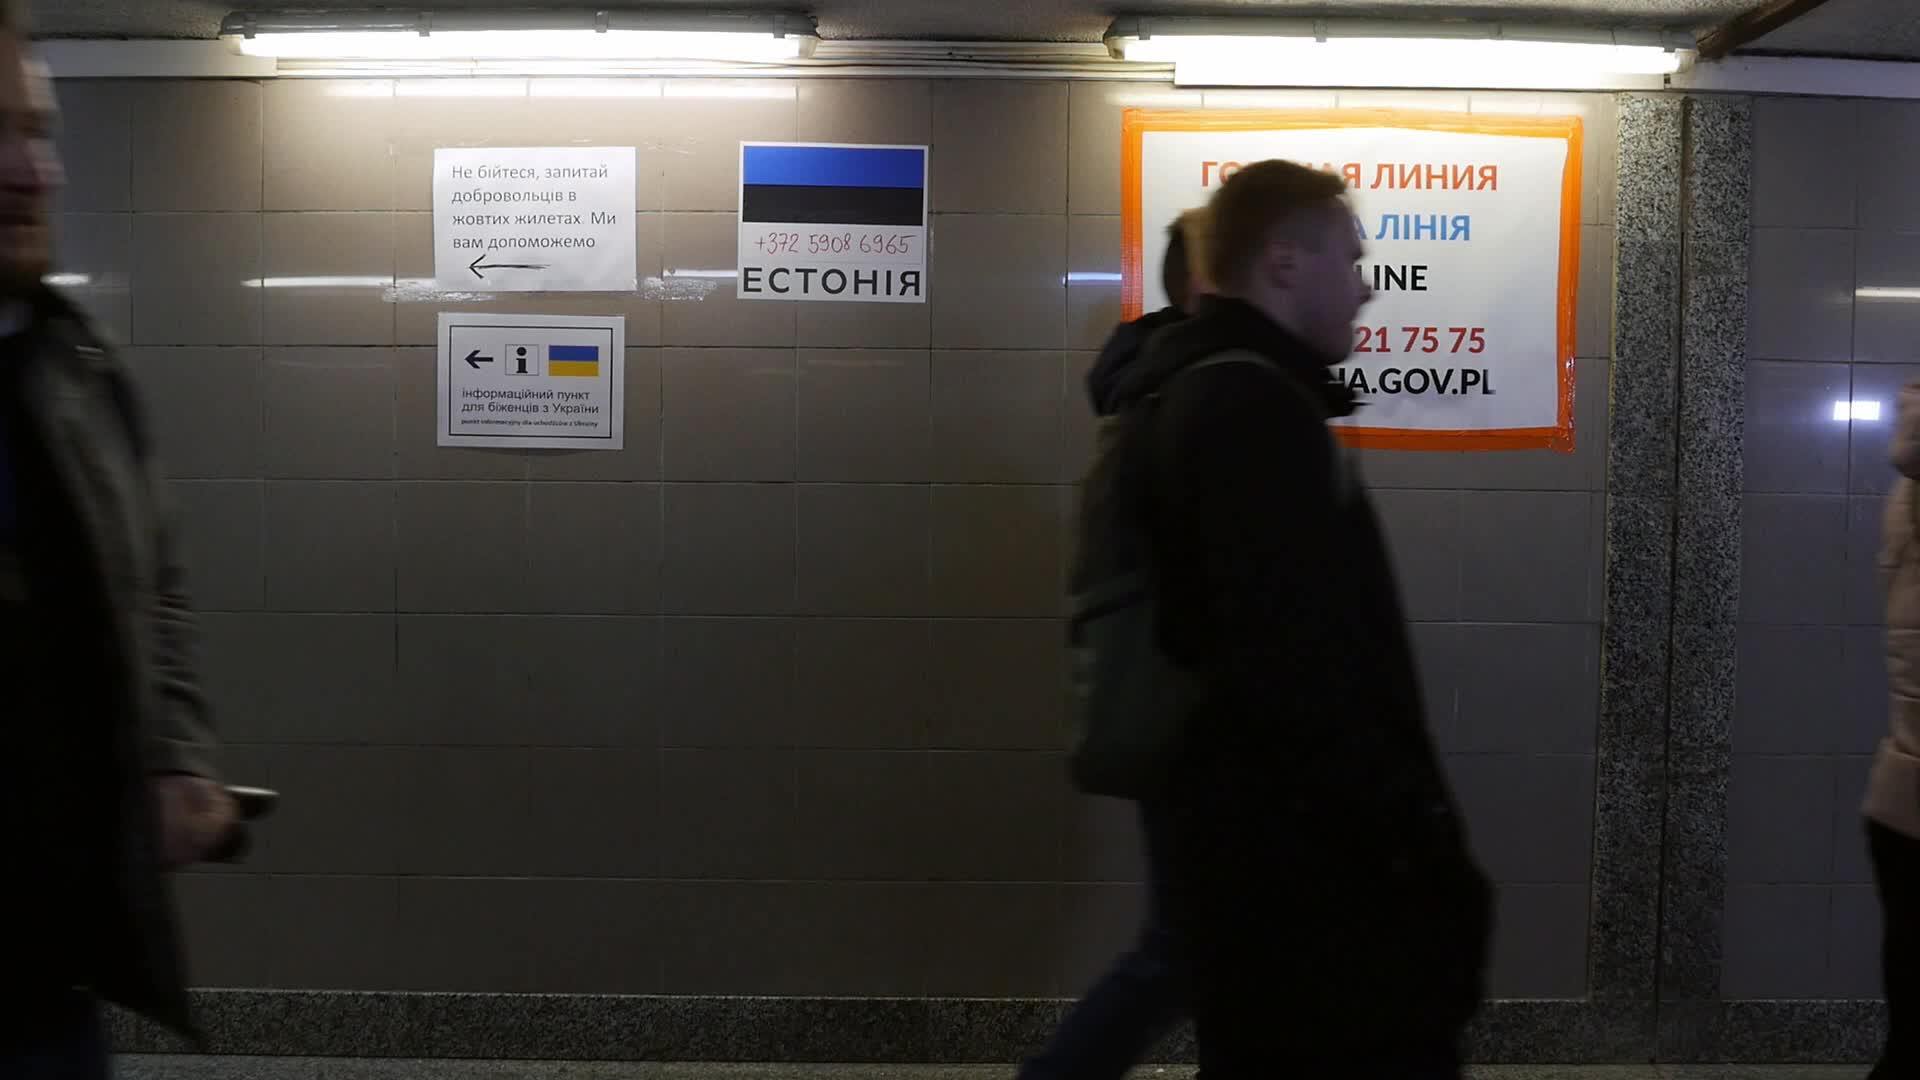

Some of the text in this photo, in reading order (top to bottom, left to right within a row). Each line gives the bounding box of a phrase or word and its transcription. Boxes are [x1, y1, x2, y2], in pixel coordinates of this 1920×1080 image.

[452, 164, 609, 181] Не бійтеся, запитай
[1370, 163, 1498, 191] ЛИНИЯ
[451, 189, 577, 206] добровольців в
[452, 213, 510, 226] жовтих
[590, 211, 616, 225] Ми
[1375, 213, 1471, 241] ЛІНІЯ
[453, 236, 596, 251] вам допоможемо
[754, 232, 917, 255] +372 5908 6965
[743, 267, 921, 297] ЕСТОНІЯ
[1401, 326, 1440, 354] 75
[1448, 327, 1486, 354] 75
[461, 388, 591, 406] інформаційний пункт
[461, 402, 485, 413] для
[488, 401, 540, 415] біженців
[552, 402, 600, 416] України
